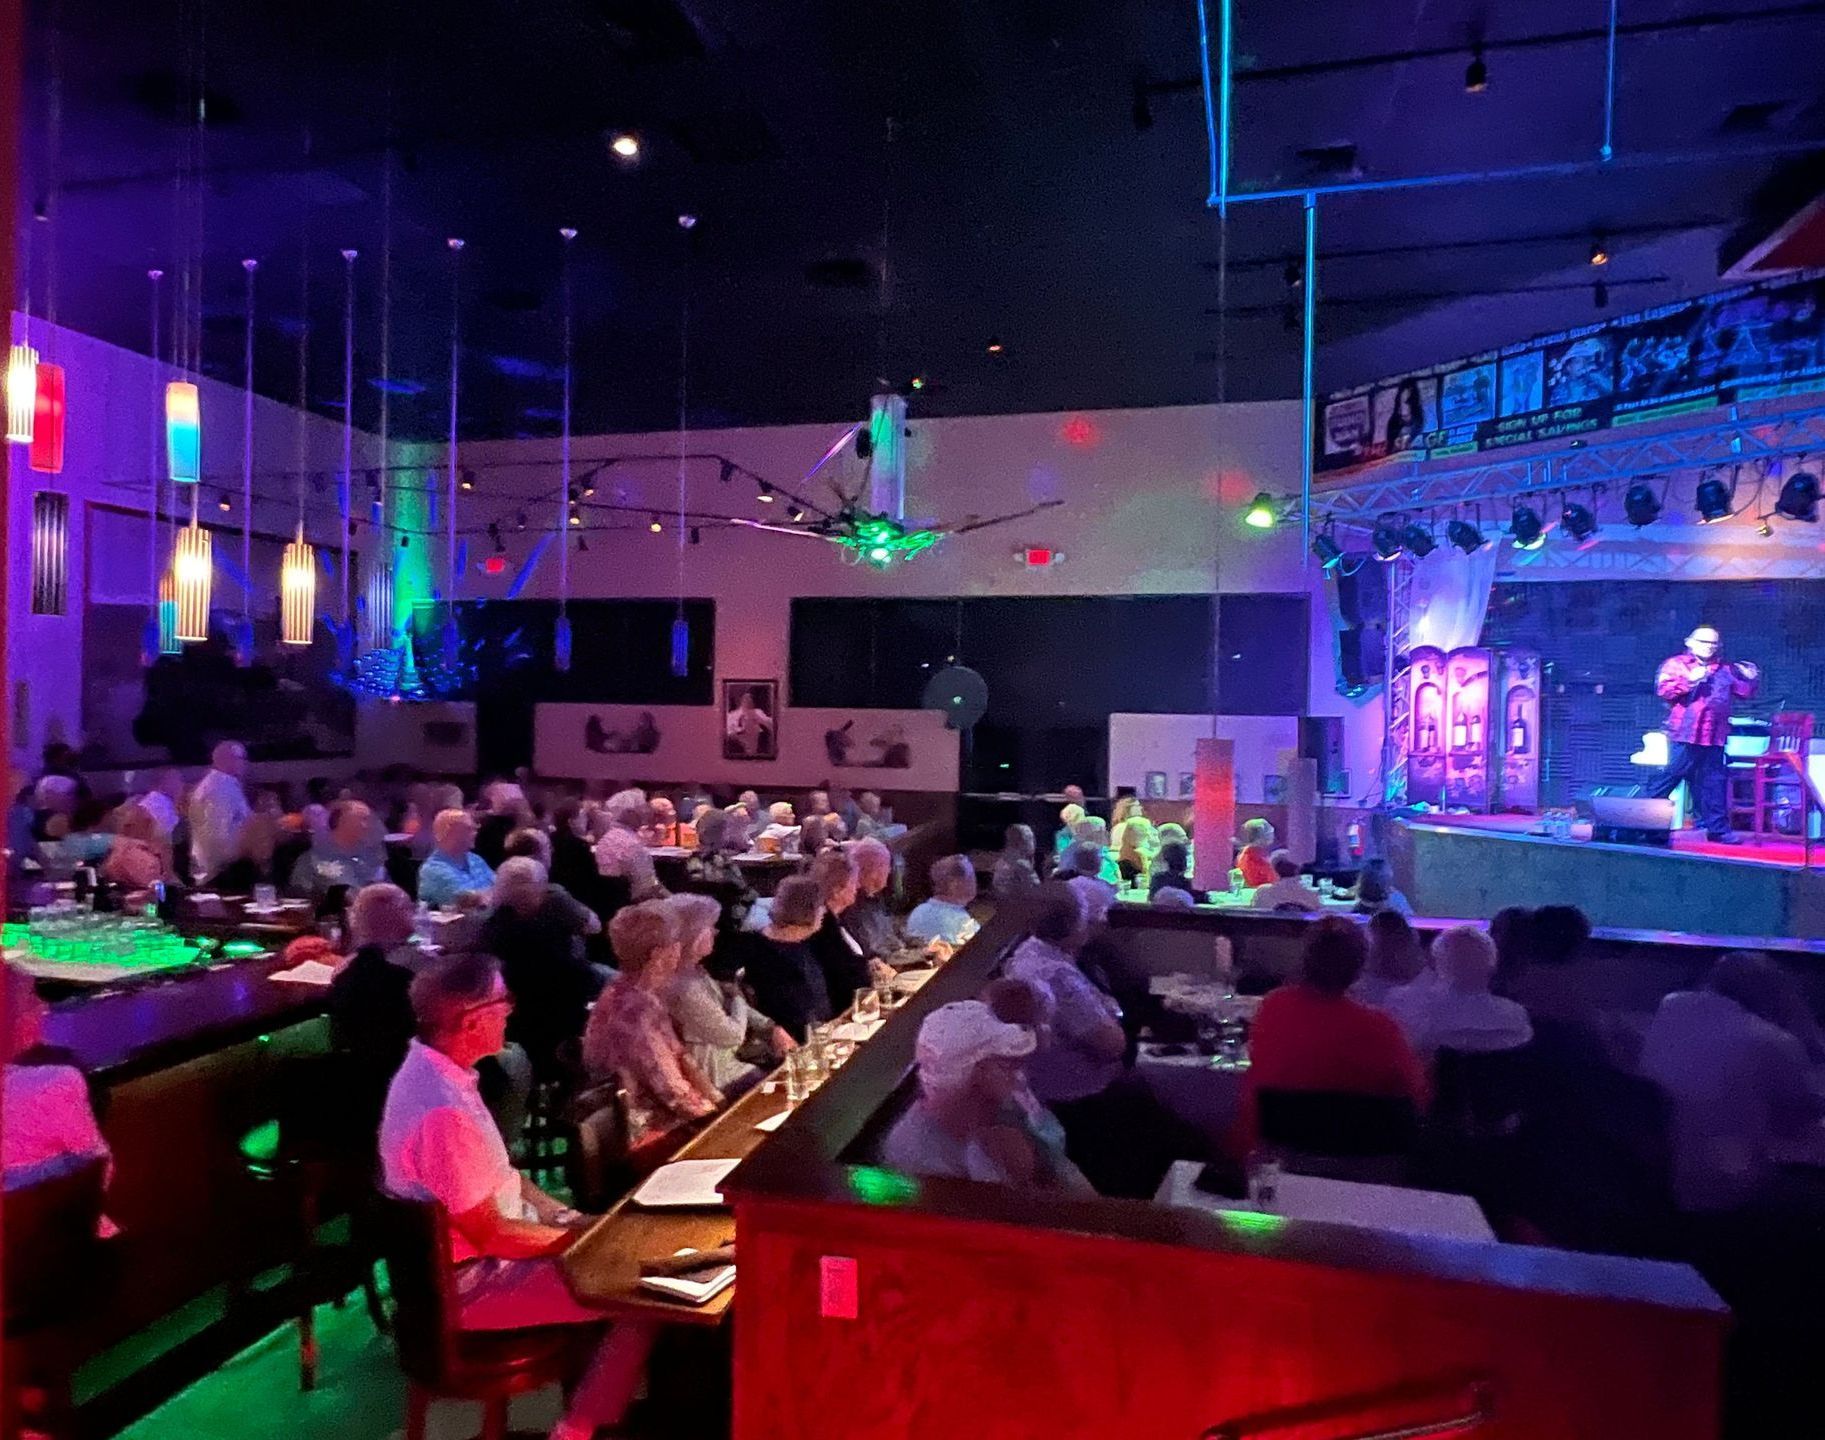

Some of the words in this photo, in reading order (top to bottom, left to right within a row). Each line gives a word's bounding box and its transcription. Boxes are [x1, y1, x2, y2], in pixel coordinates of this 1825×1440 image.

[1497, 418, 1527, 433] SIGN
[1531, 413, 1549, 426] UP
[1554, 406, 1583, 421] FOR
[1537, 417, 1599, 440] SAVINGS
